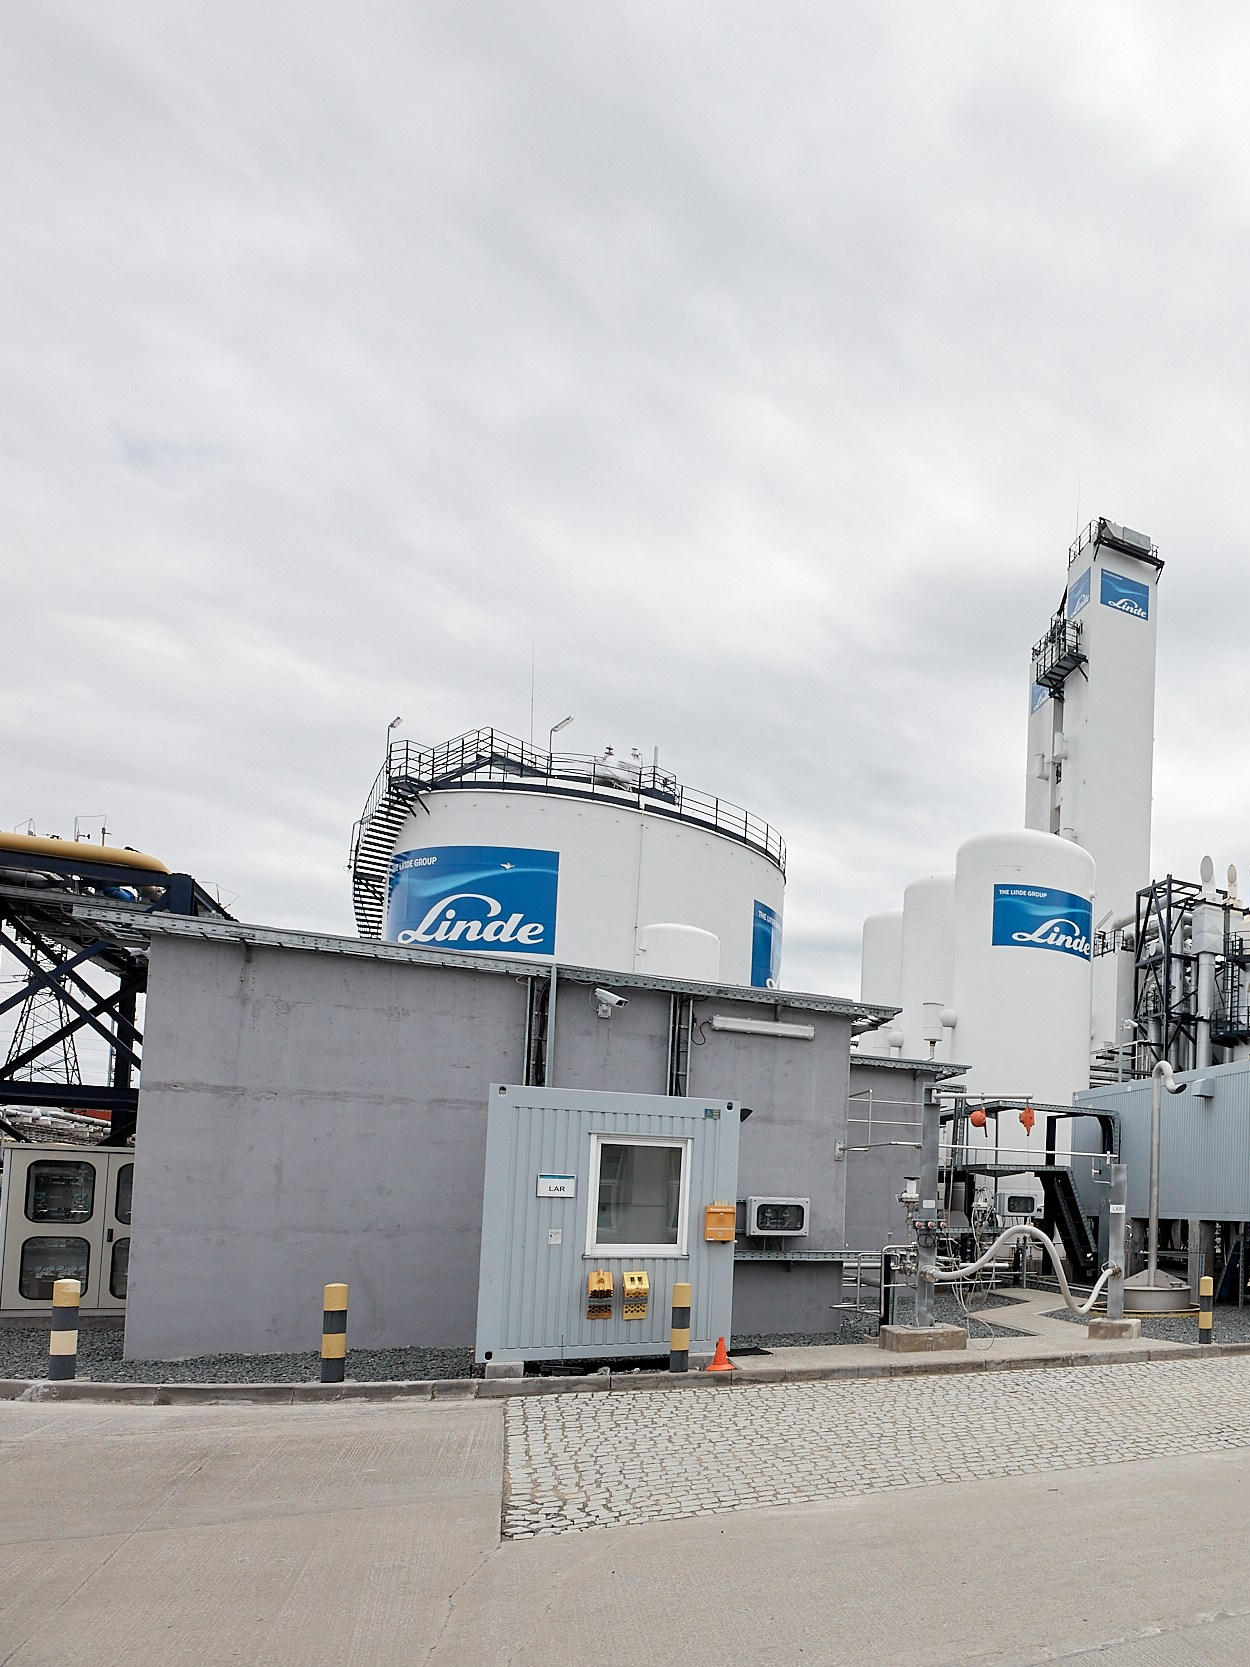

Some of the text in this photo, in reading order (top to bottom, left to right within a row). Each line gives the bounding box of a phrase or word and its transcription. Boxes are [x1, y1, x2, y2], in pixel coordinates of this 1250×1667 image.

[1107, 598, 1147, 618] Linde
[414, 856, 437, 867] GROUP
[1010, 889, 1027, 897] LINDE
[1027, 890, 1047, 898] GROUP
[397, 893, 545, 945] Linde
[1011, 918, 1090, 956] Linde
